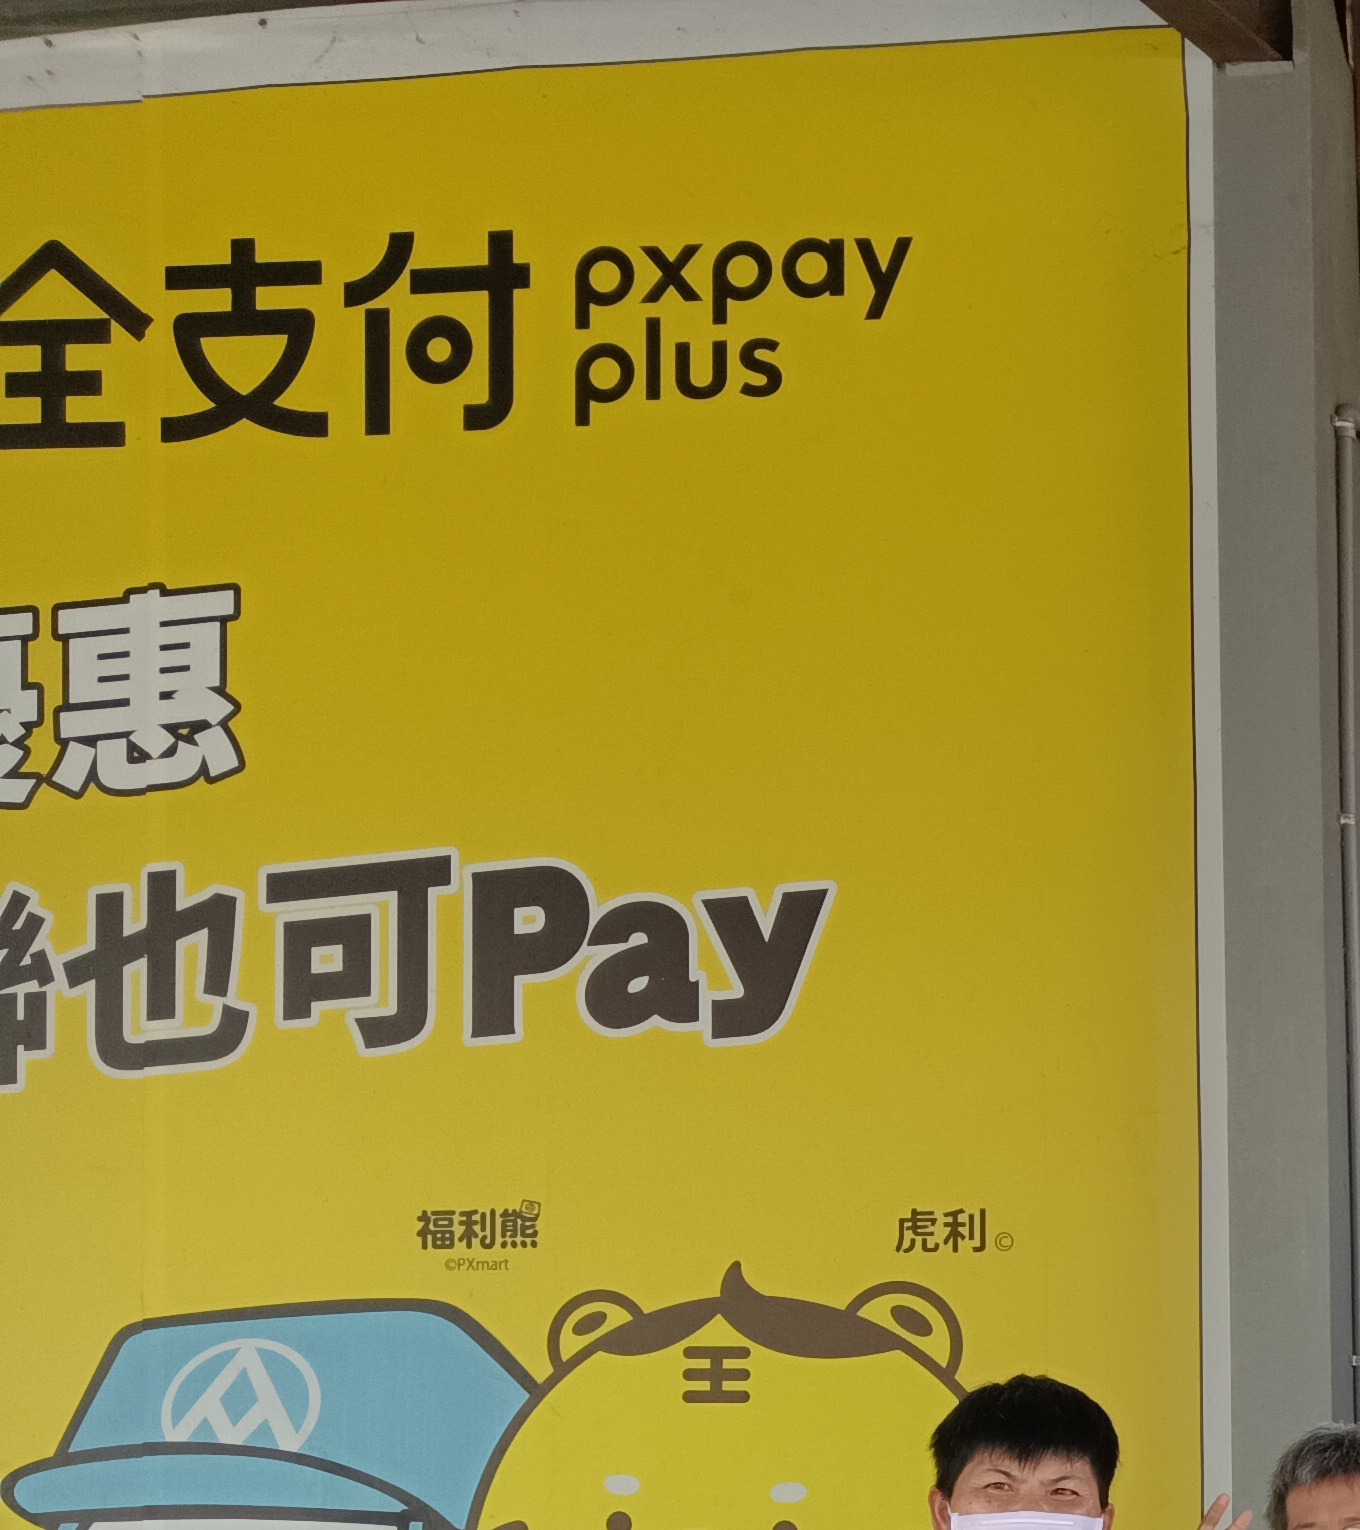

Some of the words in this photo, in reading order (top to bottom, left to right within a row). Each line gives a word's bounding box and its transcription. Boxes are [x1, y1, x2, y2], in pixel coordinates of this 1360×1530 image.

[575, 236, 913, 330] pxpay
[0, 229, 531, 450] 全支付
[575, 316, 784, 427] plus
[0, 583, 246, 810] 惠
[416, 1207, 538, 1250] 福利熊
[894, 1208, 986, 1254] 虎利
